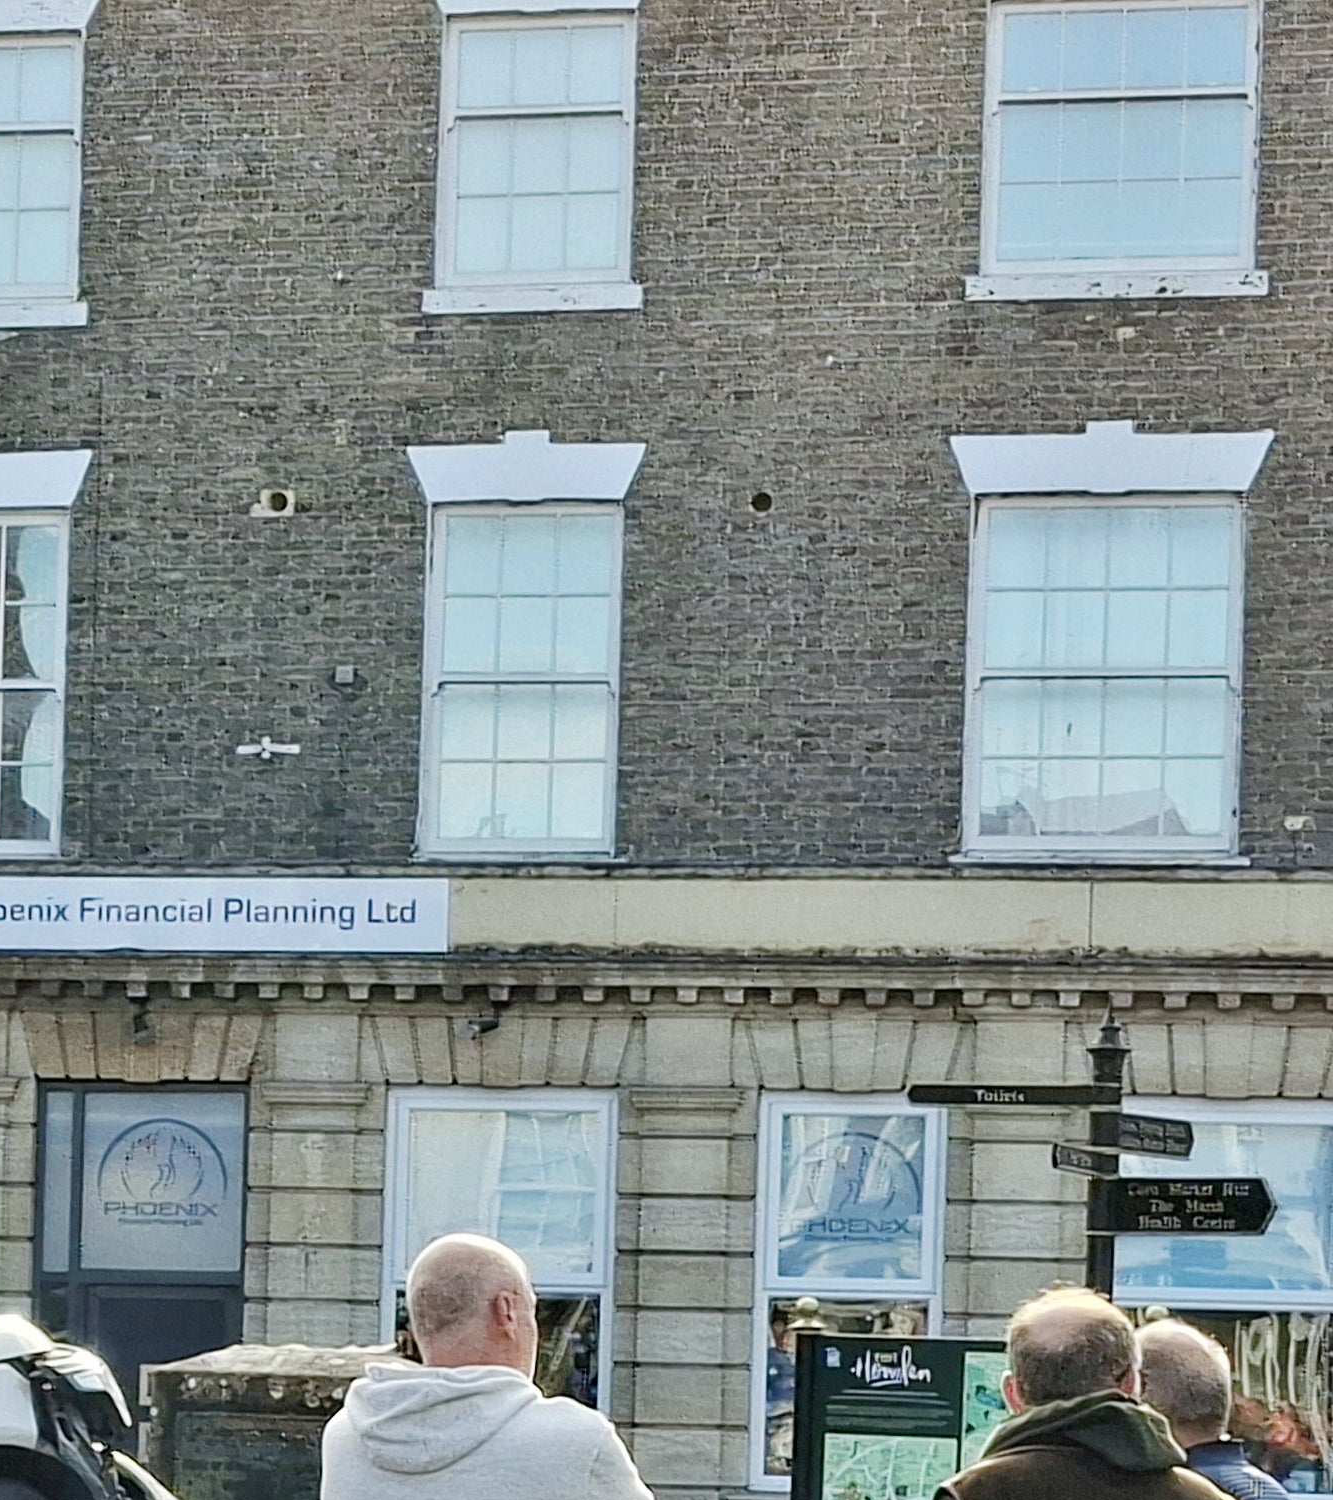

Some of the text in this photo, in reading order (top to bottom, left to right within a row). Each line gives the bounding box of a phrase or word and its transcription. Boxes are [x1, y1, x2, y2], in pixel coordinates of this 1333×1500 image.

[79, 896, 212, 924] Financial
[224, 897, 355, 931] Planning
[367, 898, 417, 924] Ltd
[974, 1088, 1025, 1103] Toilets
[103, 1200, 219, 1218] PHOENIX
[1149, 1199, 1175, 1213] The
[1137, 1215, 1183, 1230] Health
